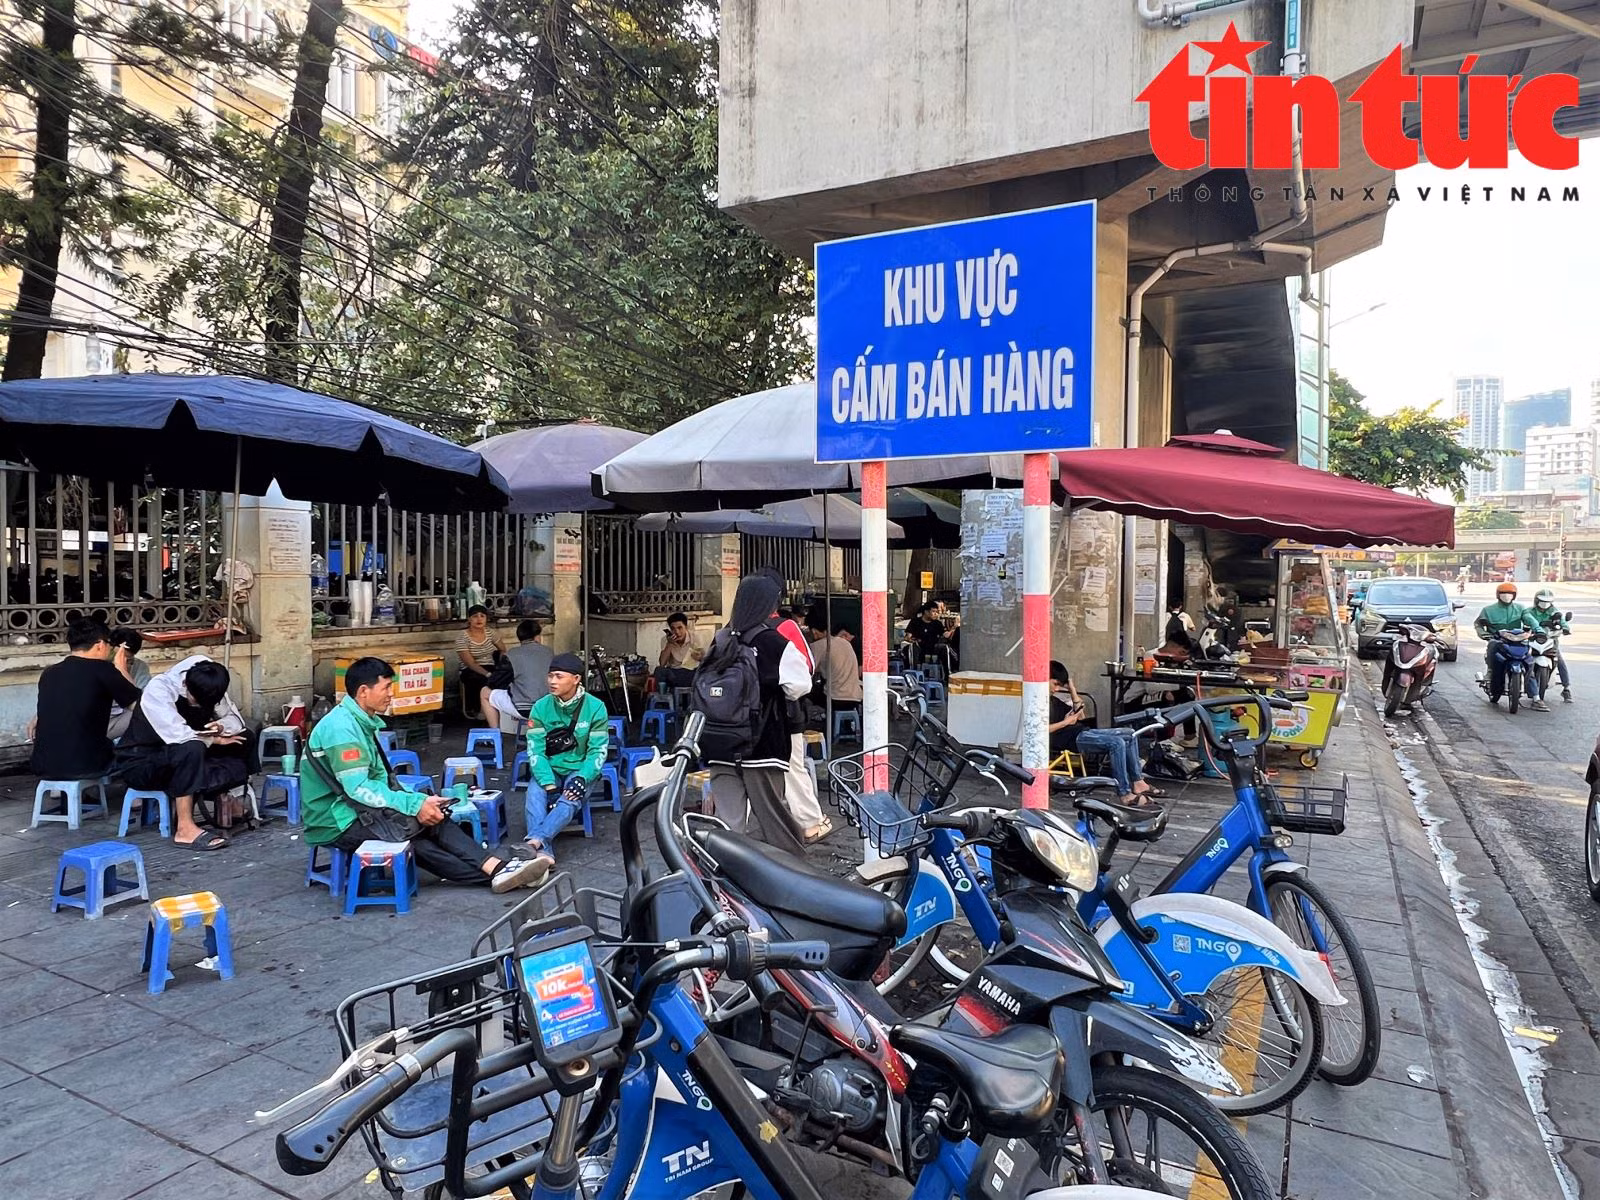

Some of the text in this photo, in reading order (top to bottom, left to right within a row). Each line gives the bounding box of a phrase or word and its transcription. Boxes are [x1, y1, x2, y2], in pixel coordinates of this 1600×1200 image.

[884, 248, 1018, 328] KHU VỰC
[832, 341, 1074, 424] CẤM BÁN HÀNG
[914, 897, 937, 918] TN
[978, 975, 1021, 1015] YAMAHA
[662, 1140, 710, 1174] TN
[692, 1158, 714, 1171] GROUP
